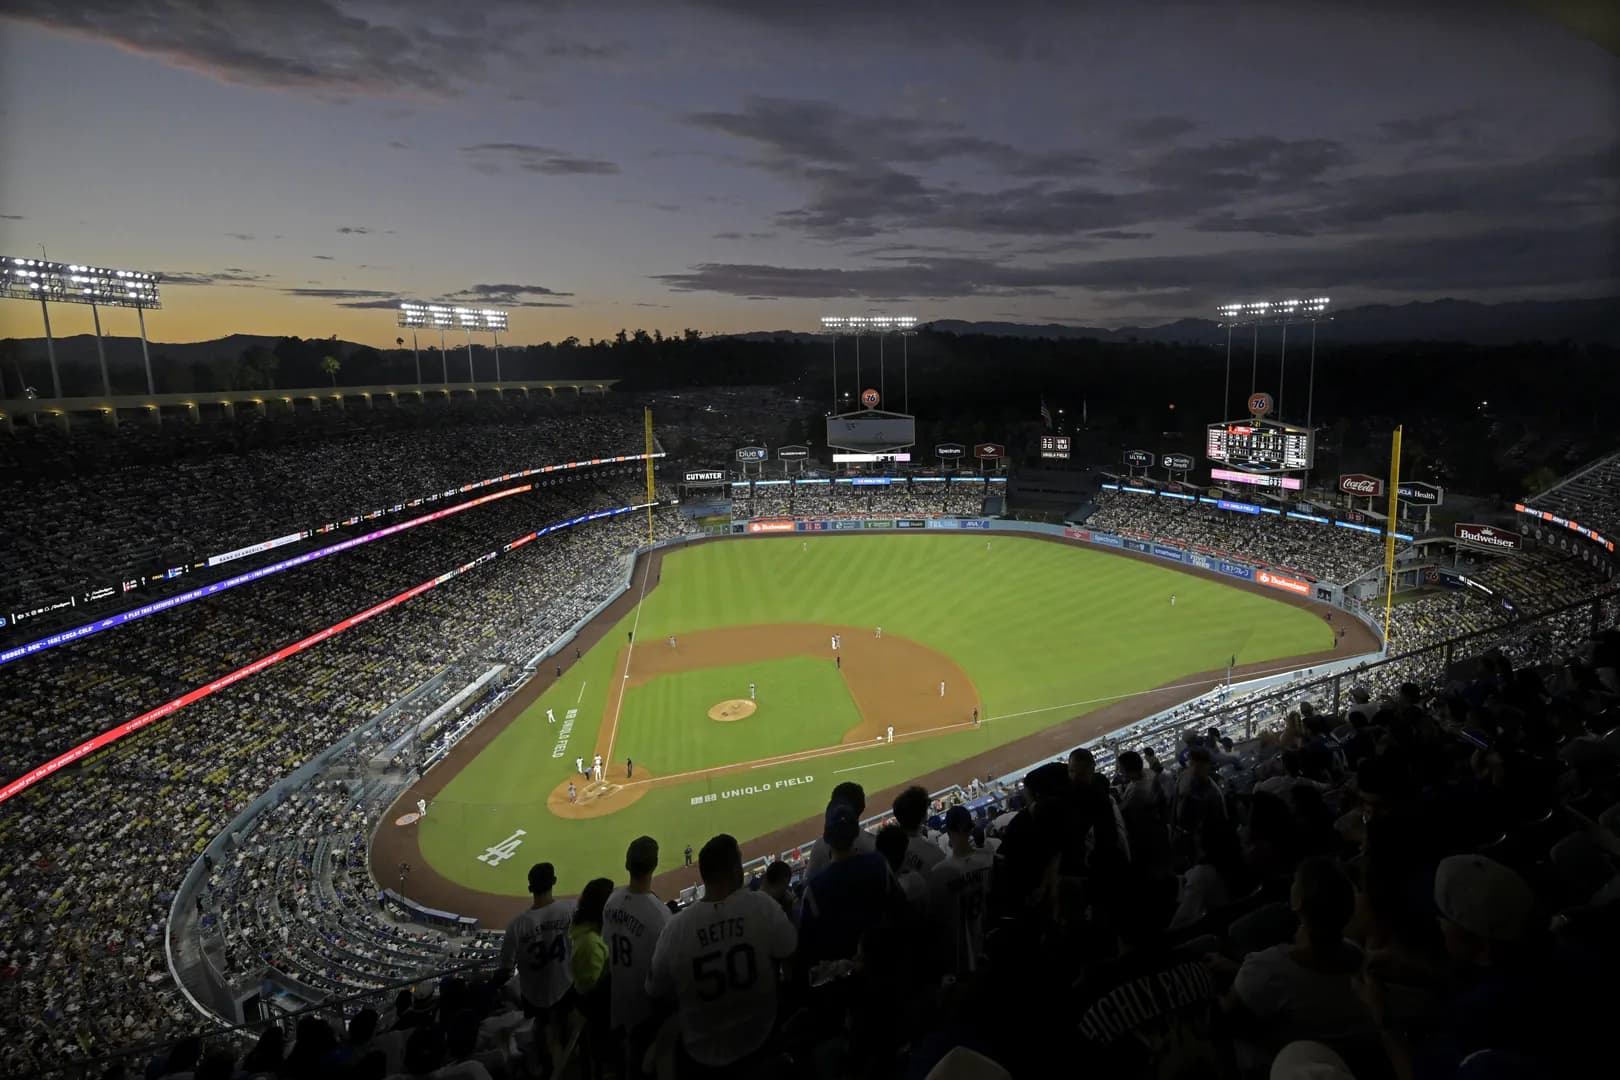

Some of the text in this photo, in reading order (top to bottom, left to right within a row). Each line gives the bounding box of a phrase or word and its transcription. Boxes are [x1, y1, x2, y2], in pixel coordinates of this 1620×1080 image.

[866, 393, 877, 402] 76
[1253, 400, 1265, 409] 76
[1414, 491, 1435, 499] Health
[1460, 530, 1514, 548] Budweiser
[1271, 576, 1308, 592] Budweiser
[552, 740, 568, 758] FIELD
[721, 776, 814, 799] UNIQLO FIELD
[696, 917, 744, 947] BETTS
[528, 934, 564, 970] 34
[611, 934, 632, 968] 18
[692, 942, 758, 1002] 50
[1157, 960, 1209, 1009] FAVO
